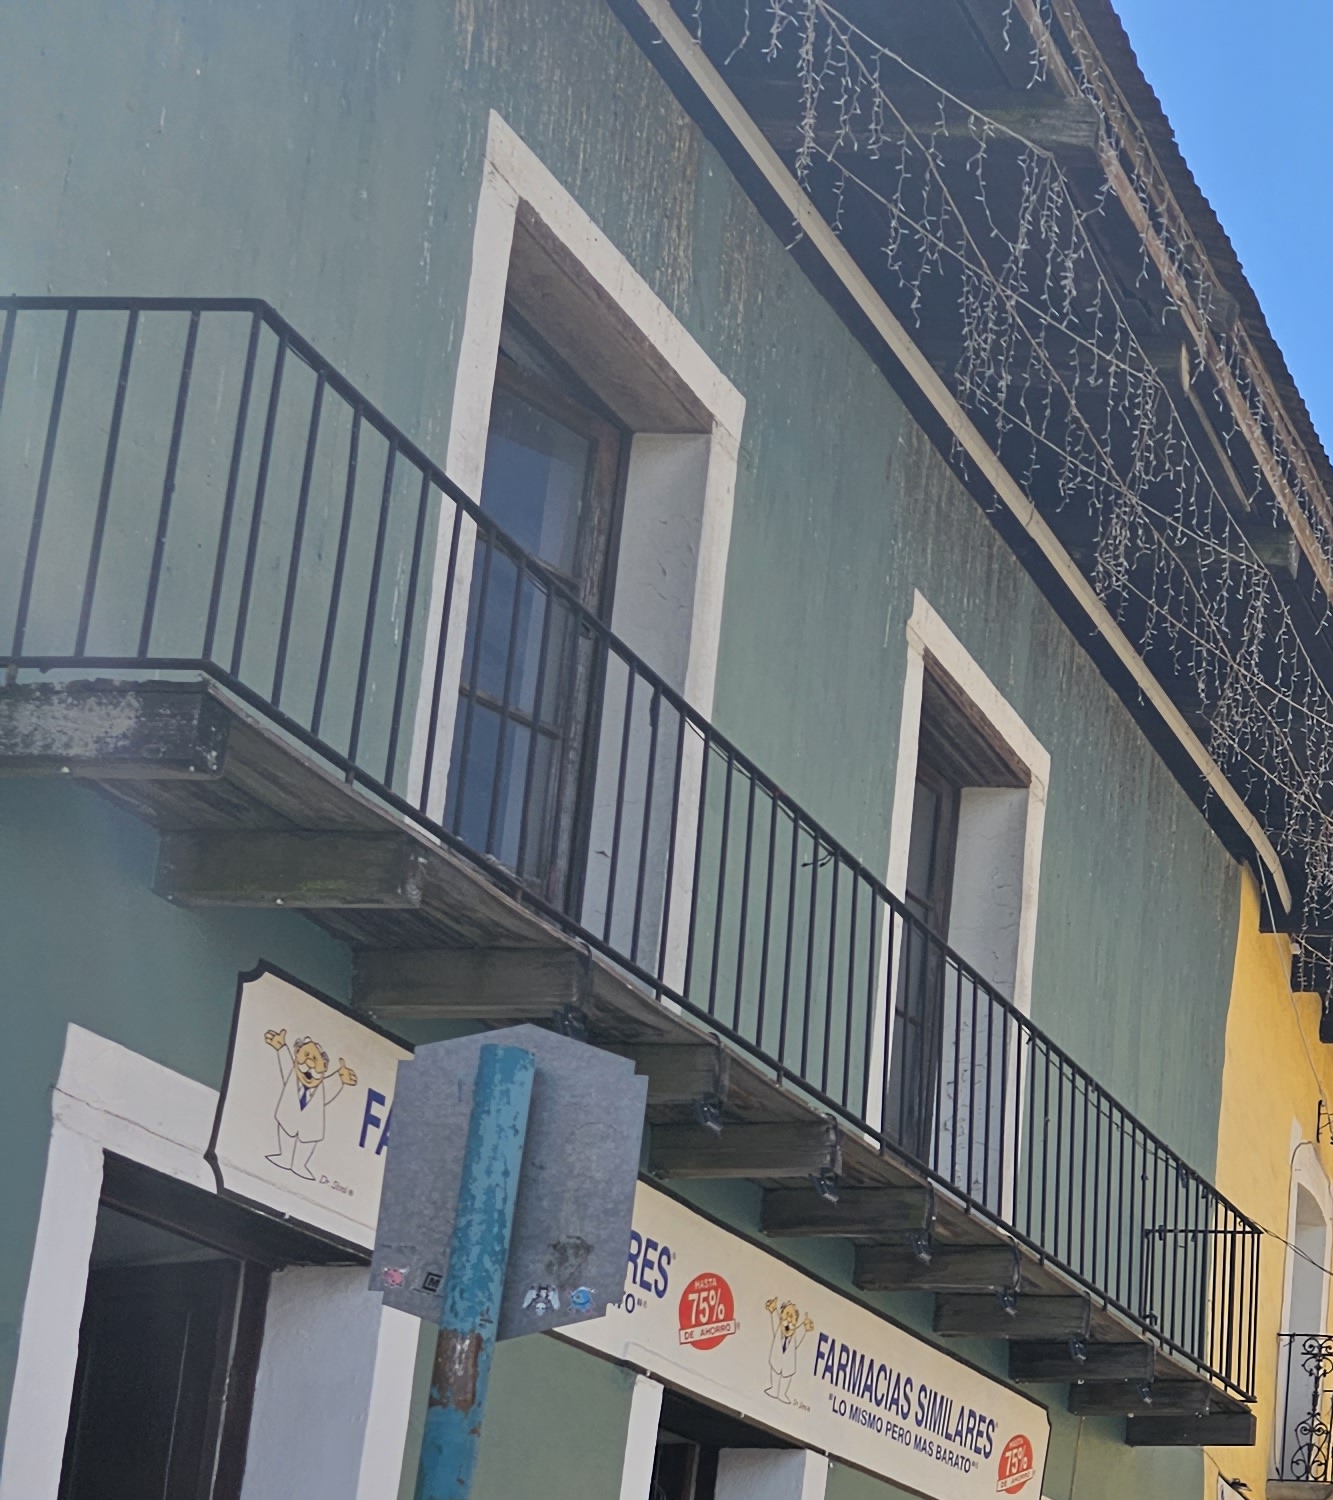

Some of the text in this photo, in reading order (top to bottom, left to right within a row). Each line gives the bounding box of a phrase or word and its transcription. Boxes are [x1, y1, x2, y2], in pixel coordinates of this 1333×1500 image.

[688, 1288, 725, 1325] 75%
[684, 1323, 731, 1341] DE AHORRO
[813, 1331, 996, 1460] FARMACIAS SIMILARES
[849, 1404, 884, 1434] MISMO
[885, 1421, 912, 1447] PERO
[913, 1437, 934, 1458] MAS
[1004, 1447, 1029, 1475] 75%
